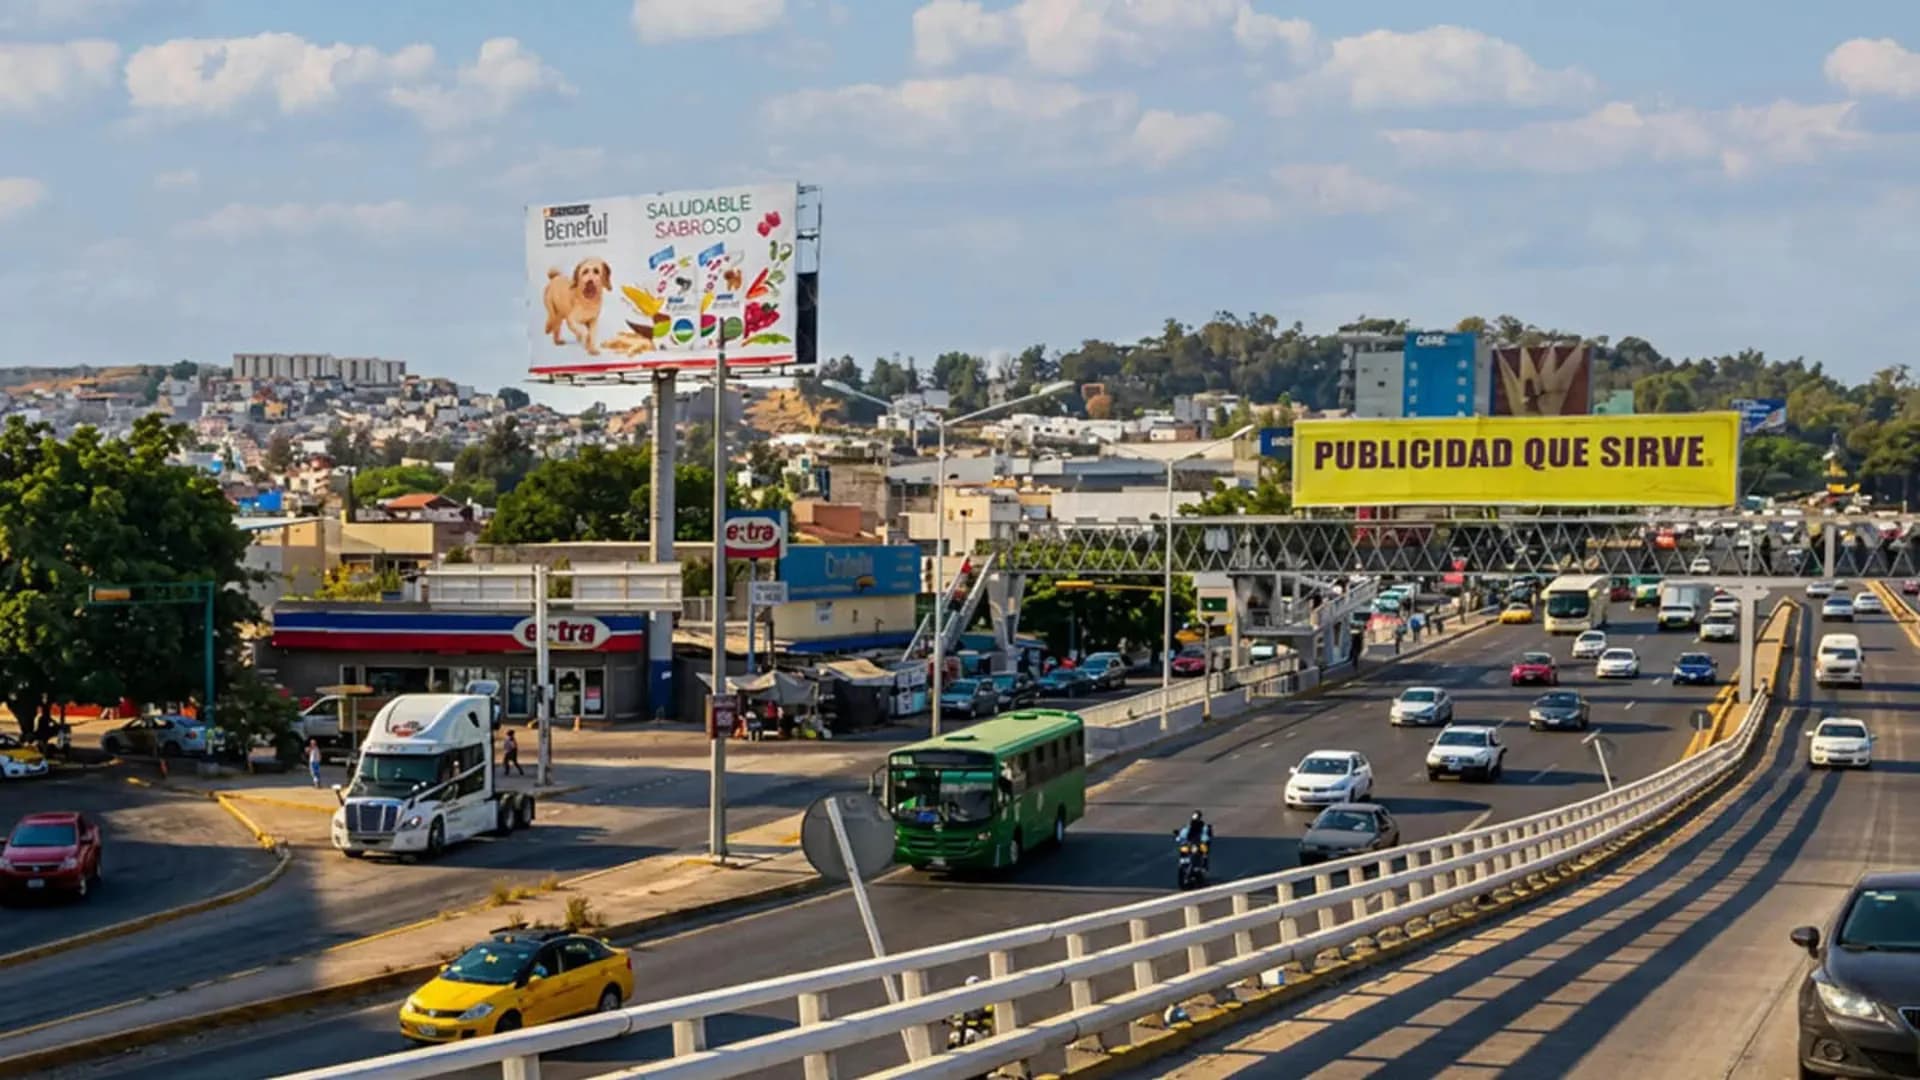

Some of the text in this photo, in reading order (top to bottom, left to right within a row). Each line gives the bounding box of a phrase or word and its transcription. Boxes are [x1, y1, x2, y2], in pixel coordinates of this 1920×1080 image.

[646, 193, 752, 219] SALUDABLE
[544, 212, 608, 241] Beneful
[655, 216, 741, 238] SABROSO
[1314, 438, 1512, 470] PUBLICIDAD
[1524, 437, 1590, 471] QUE
